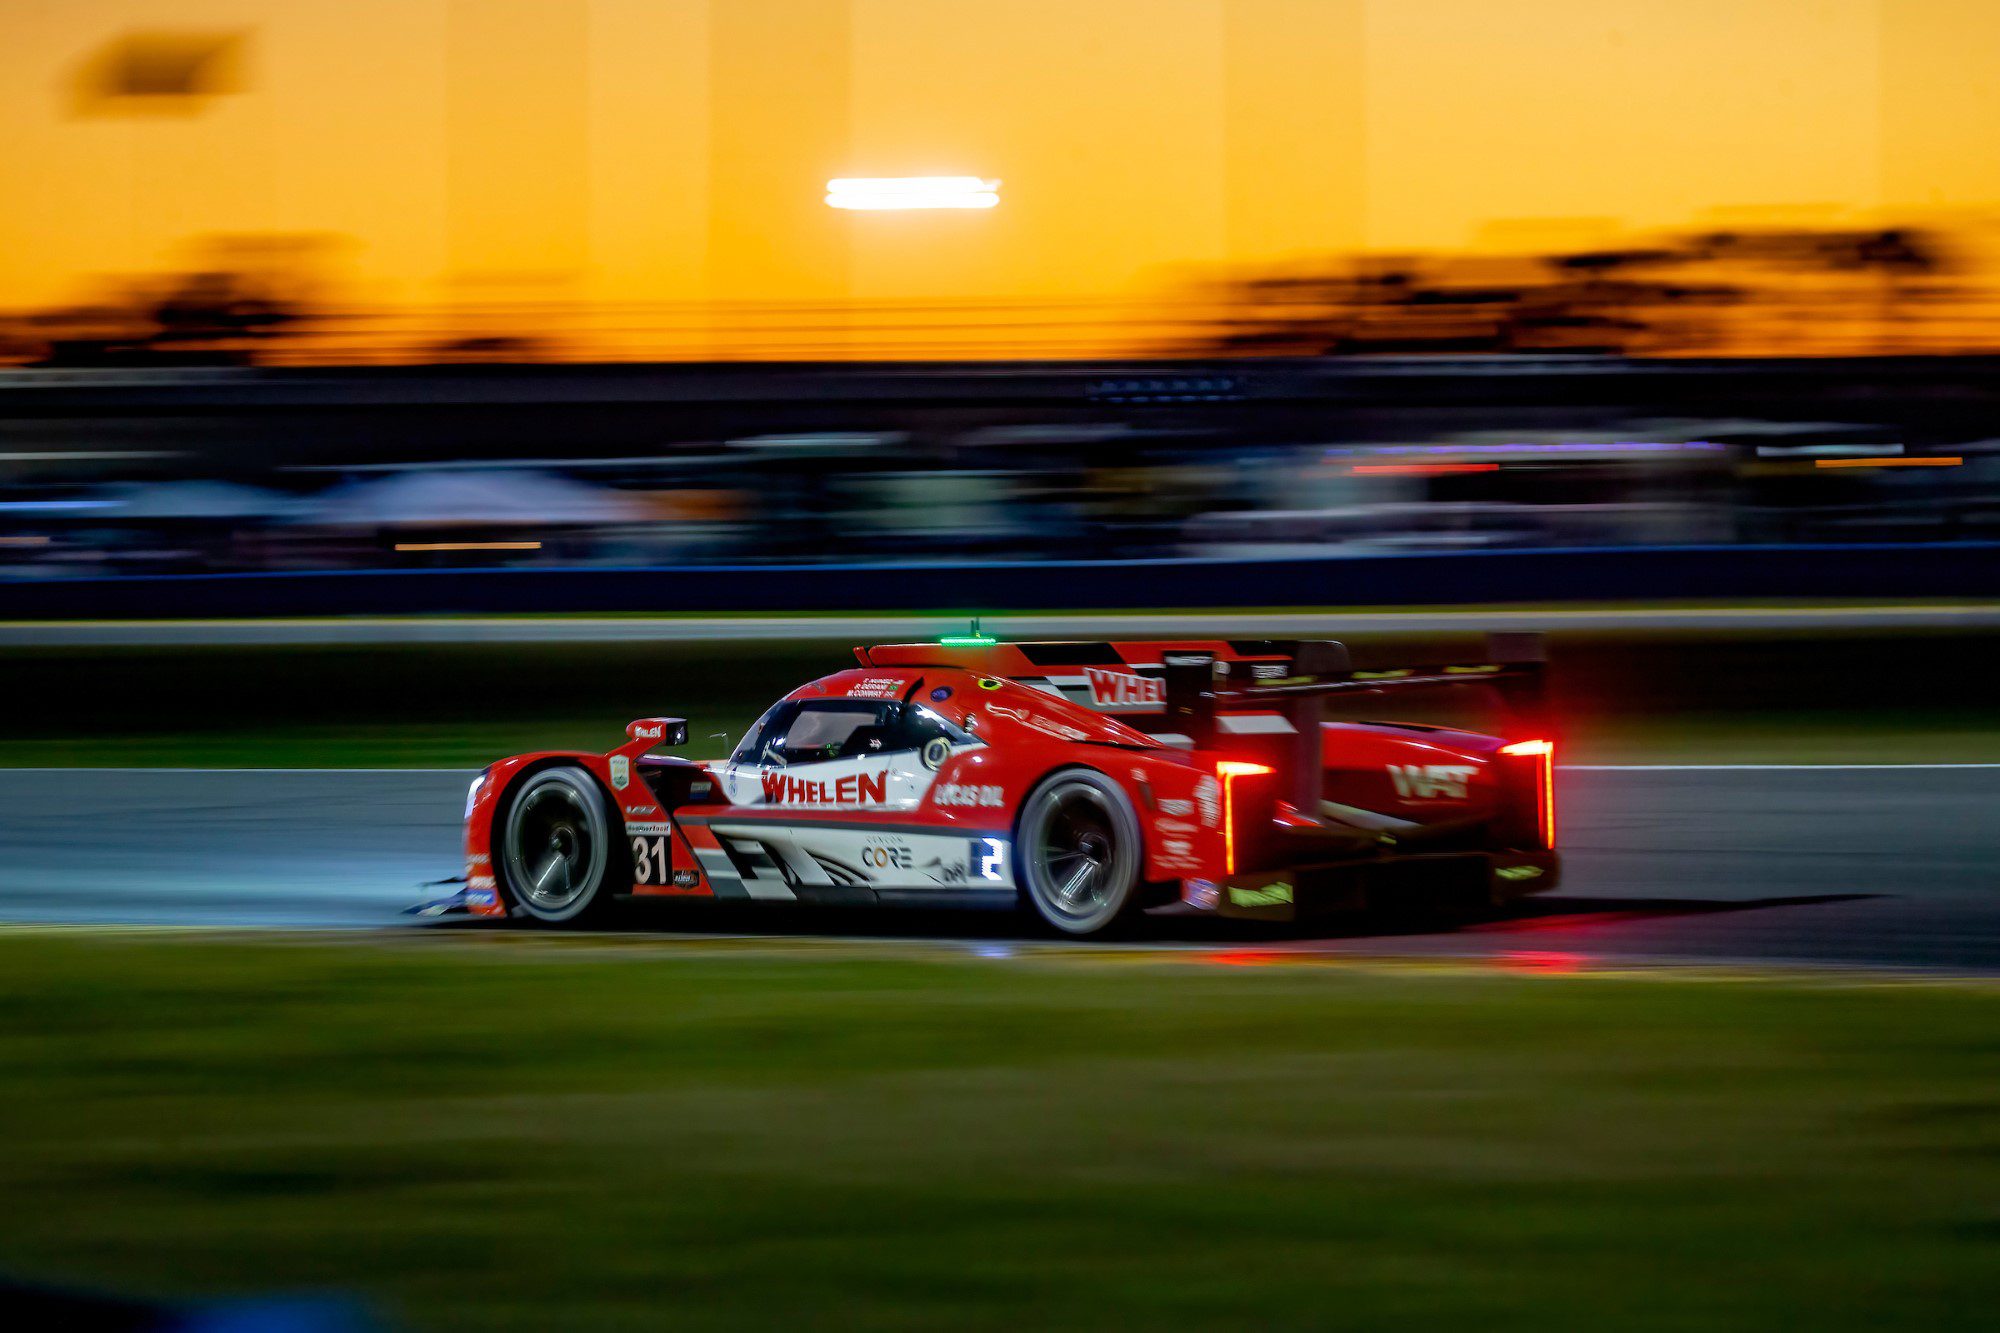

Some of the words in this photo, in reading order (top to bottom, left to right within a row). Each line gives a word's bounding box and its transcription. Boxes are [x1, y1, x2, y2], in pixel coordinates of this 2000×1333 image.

[761, 769, 888, 804] WHELEN
[632, 836, 667, 885] 31
[861, 846, 913, 869] CORE
[981, 836, 1004, 881] 2
